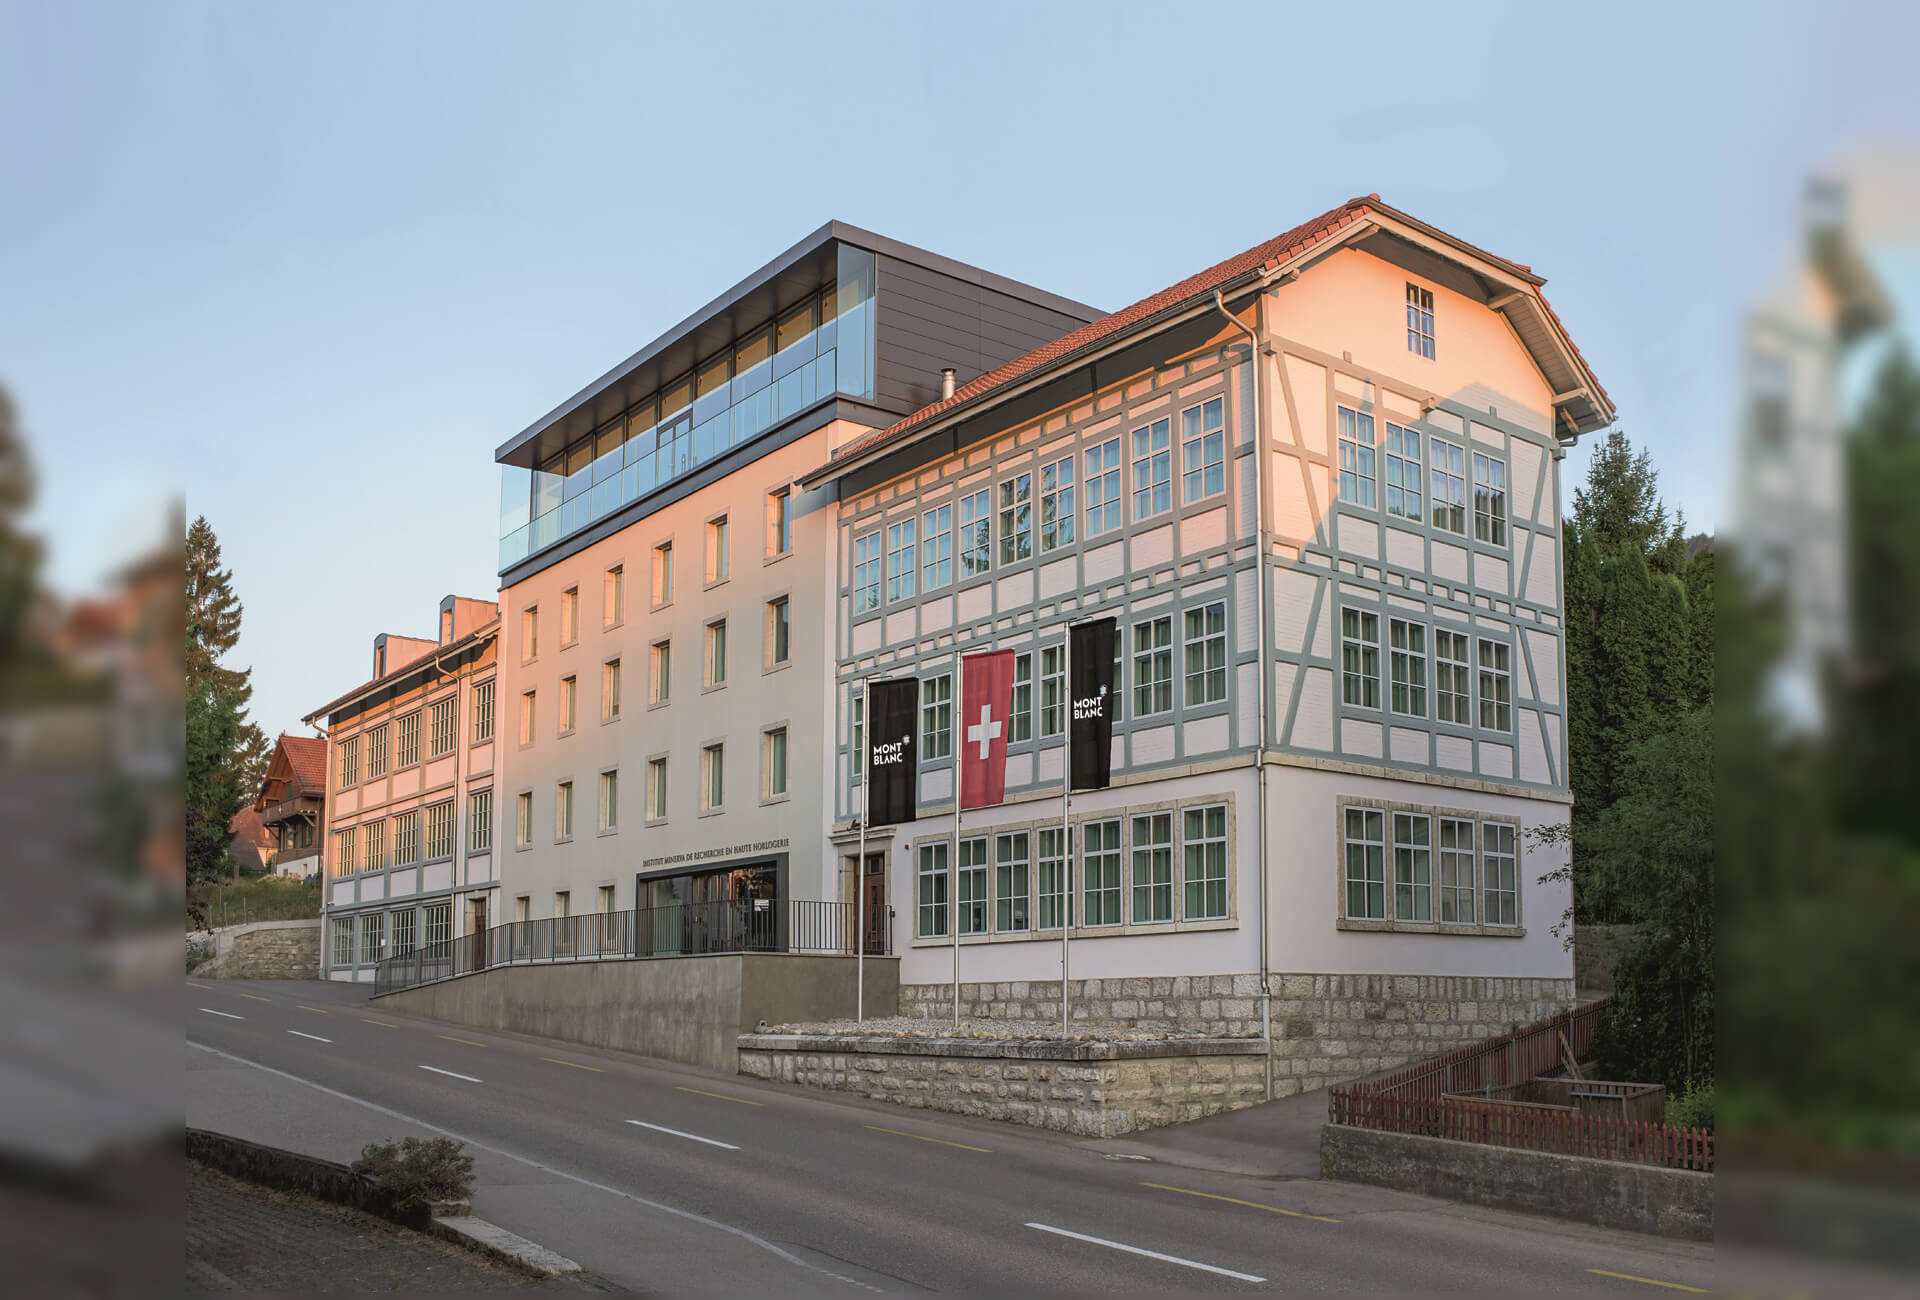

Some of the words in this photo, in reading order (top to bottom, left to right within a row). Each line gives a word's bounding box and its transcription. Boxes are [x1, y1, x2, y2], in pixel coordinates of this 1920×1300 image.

[1073, 696, 1102, 709] MONT
[1074, 706, 1103, 719] BLANC
[873, 742, 902, 755] MONT
[874, 752, 903, 765] BLANC
[642, 857, 664, 867] INSTITUT
[664, 854, 685, 864] MINERVA
[686, 852, 693, 861] DE
[694, 848, 724, 860] RECHERCHE
[725, 846, 733, 856] EN
[734, 844, 752, 854] HAUTE
[753, 838, 790, 851] HORLOGERIE
